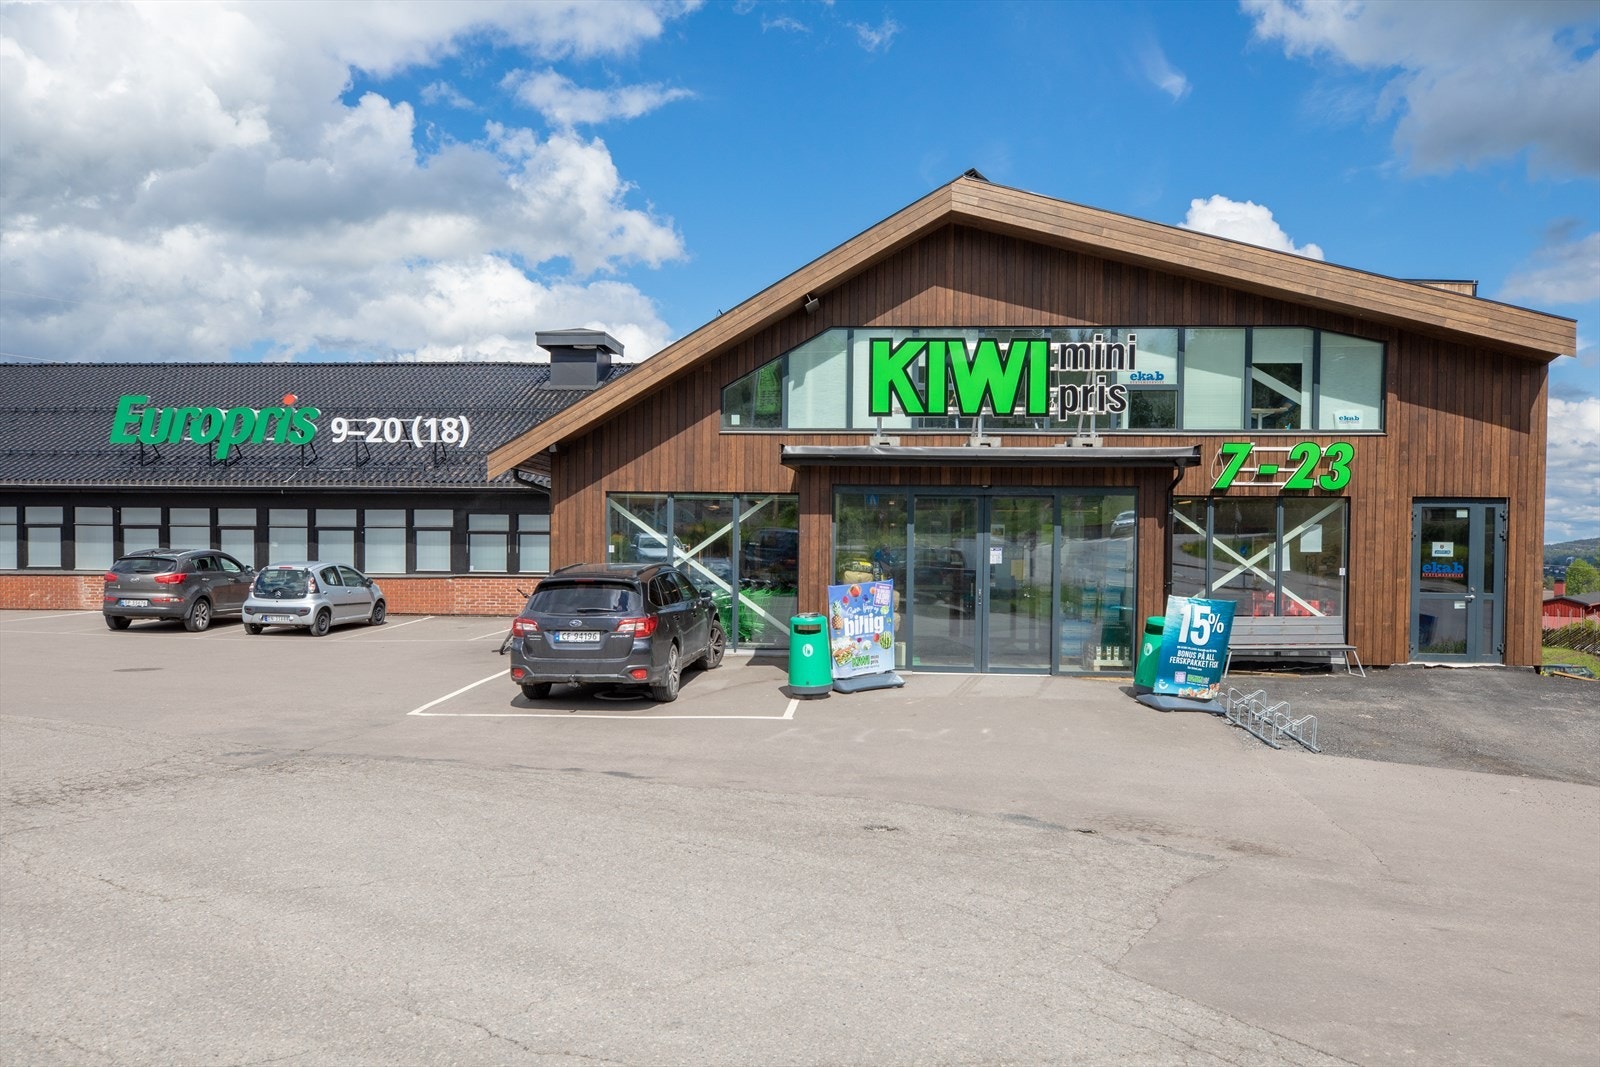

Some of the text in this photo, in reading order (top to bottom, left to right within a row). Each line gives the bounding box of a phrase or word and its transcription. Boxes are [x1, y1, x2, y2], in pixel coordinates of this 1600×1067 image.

[1058, 333, 1137, 371] mini
[868, 337, 1051, 418] KIWI
[1129, 370, 1165, 381] ekab
[1058, 375, 1128, 421] pris
[109, 394, 321, 460] Europris
[411, 415, 471, 448] (18)
[1422, 561, 1464, 573] ekab
[561, 632, 598, 640] CF 94196
[844, 613, 885, 637] billig
[1178, 603, 1225, 646] 15%
[1169, 656, 1209, 668] FERSKPAKKET
[1177, 649, 1197, 659] BONUS
[1197, 651, 1206, 660] PÅ
[1206, 653, 1215, 661] ALL
